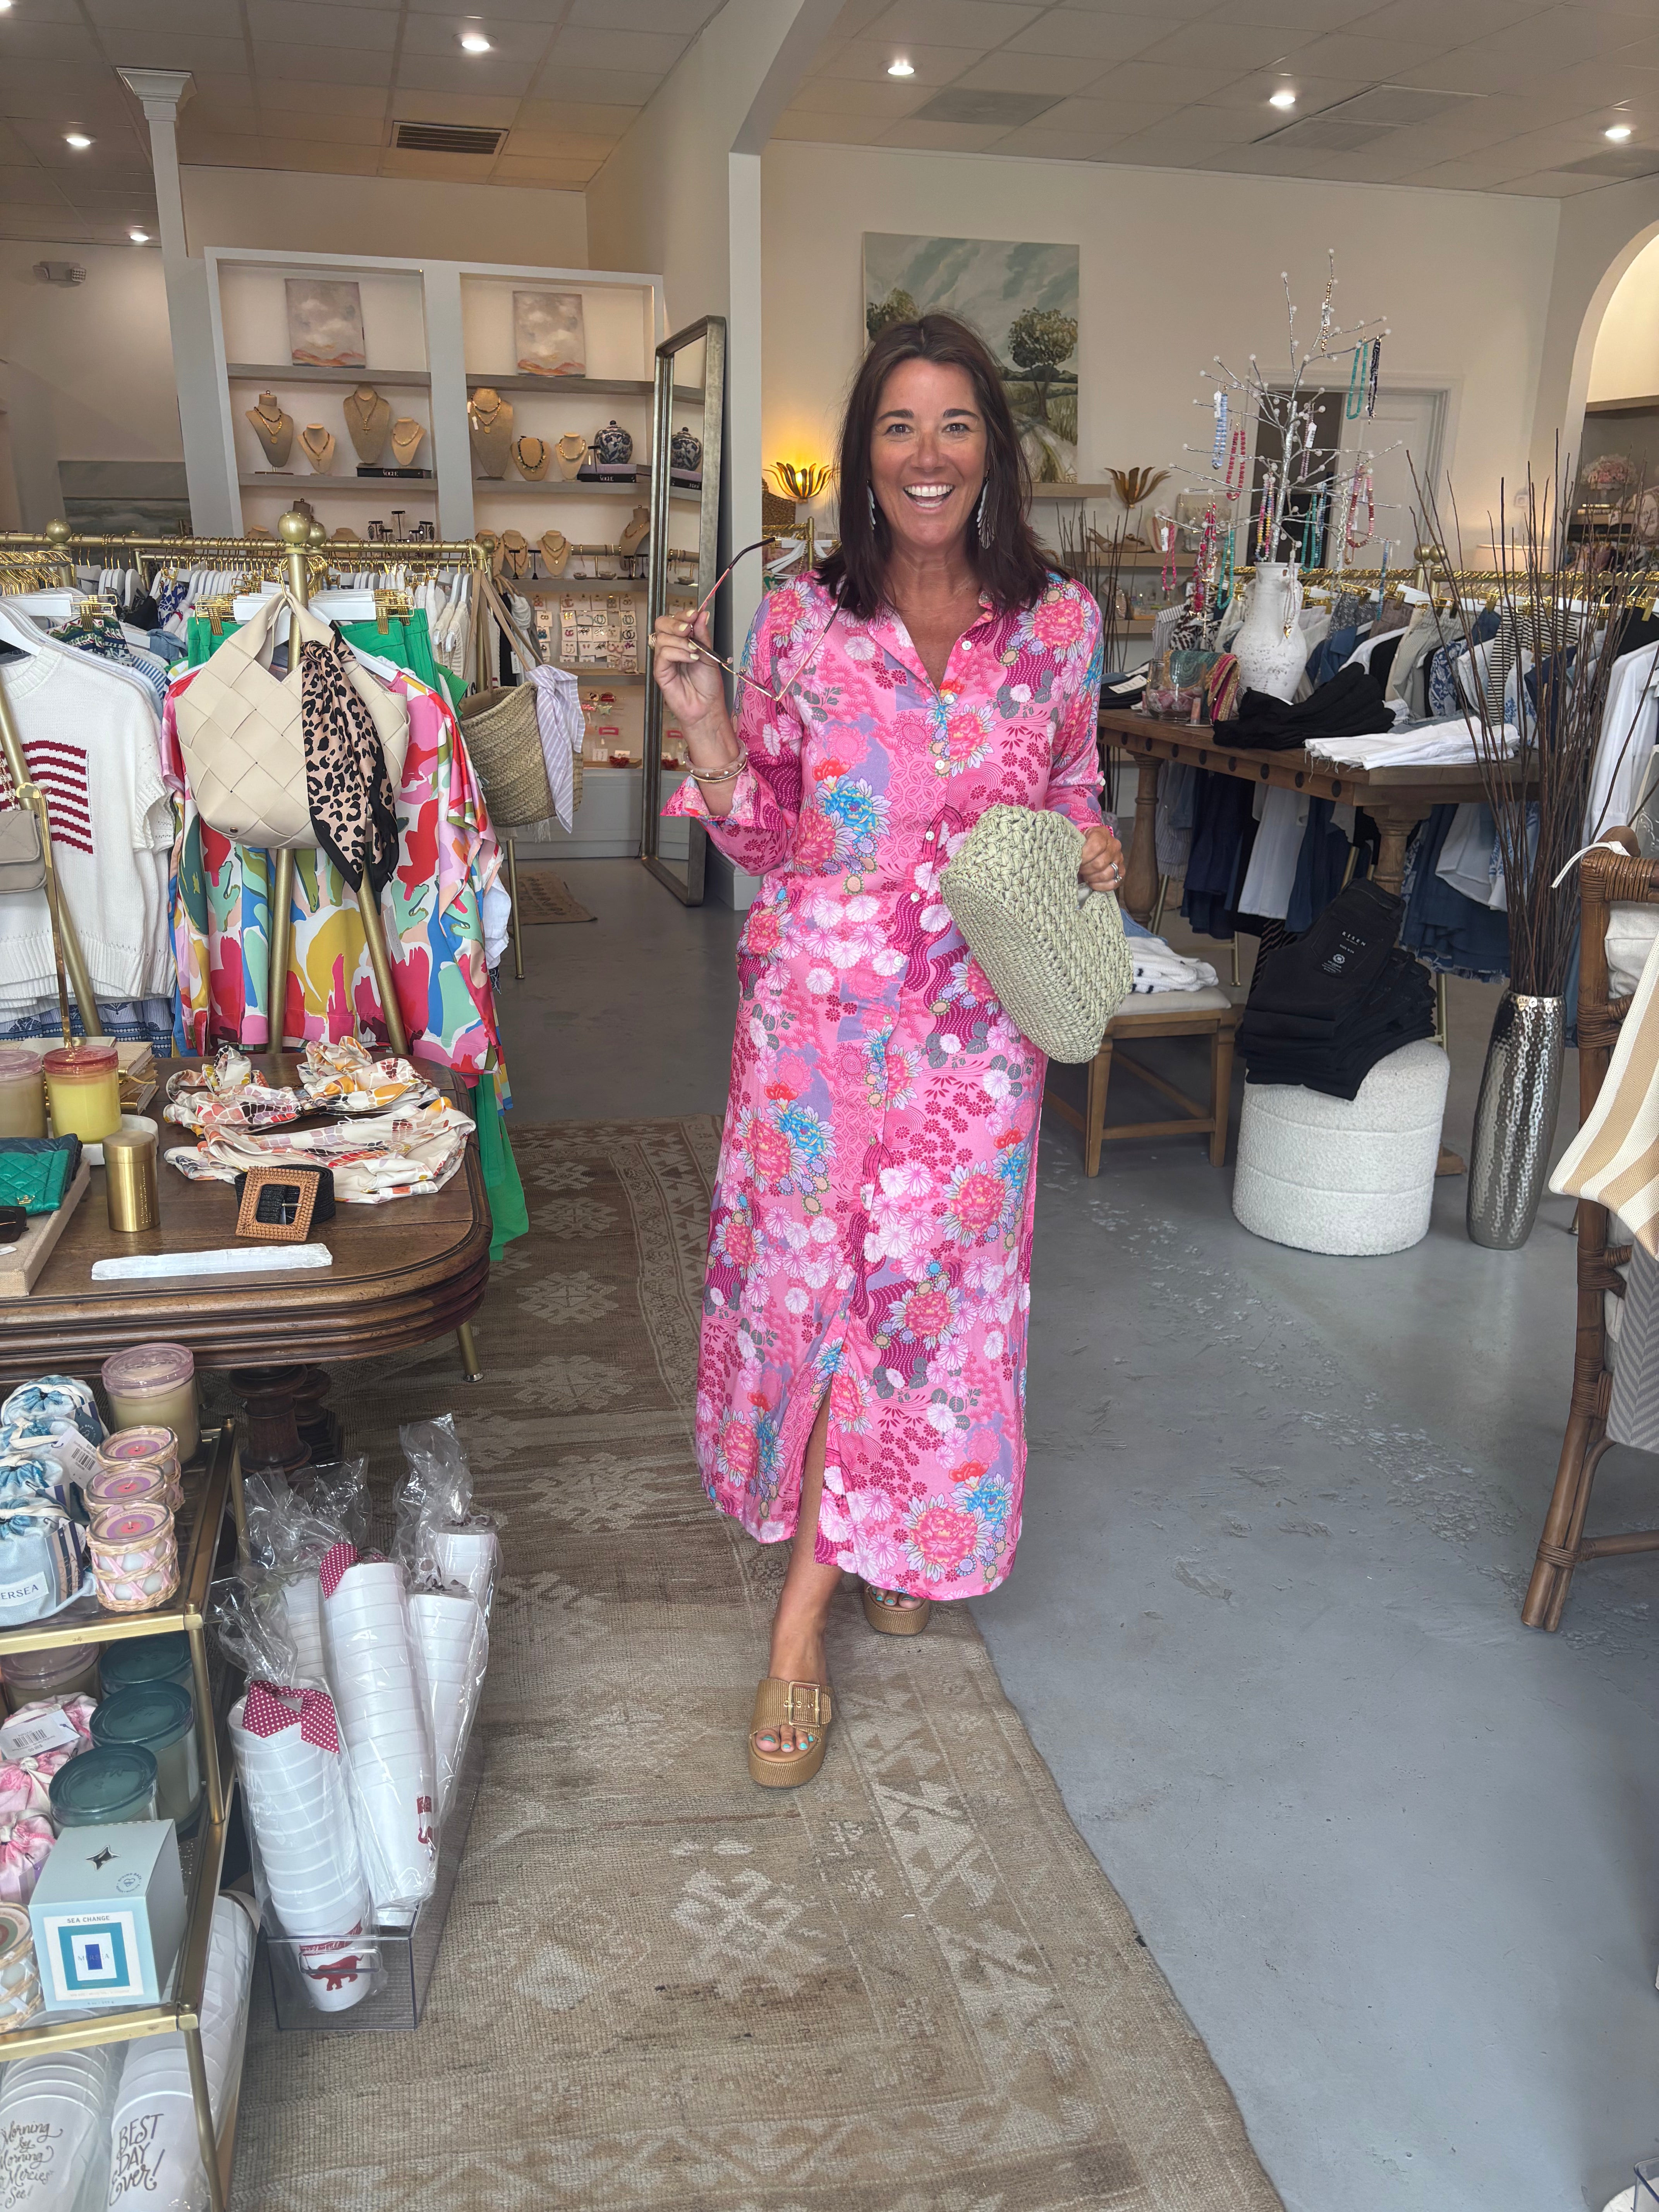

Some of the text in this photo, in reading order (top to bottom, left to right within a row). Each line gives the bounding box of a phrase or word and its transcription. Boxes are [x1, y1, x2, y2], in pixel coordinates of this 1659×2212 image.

[1342, 931, 1366, 946] RISEN
[0, 1584, 39, 1600] ERSEA
[117, 2113, 164, 2160] BEST
[117, 2142, 151, 2177] DAY
